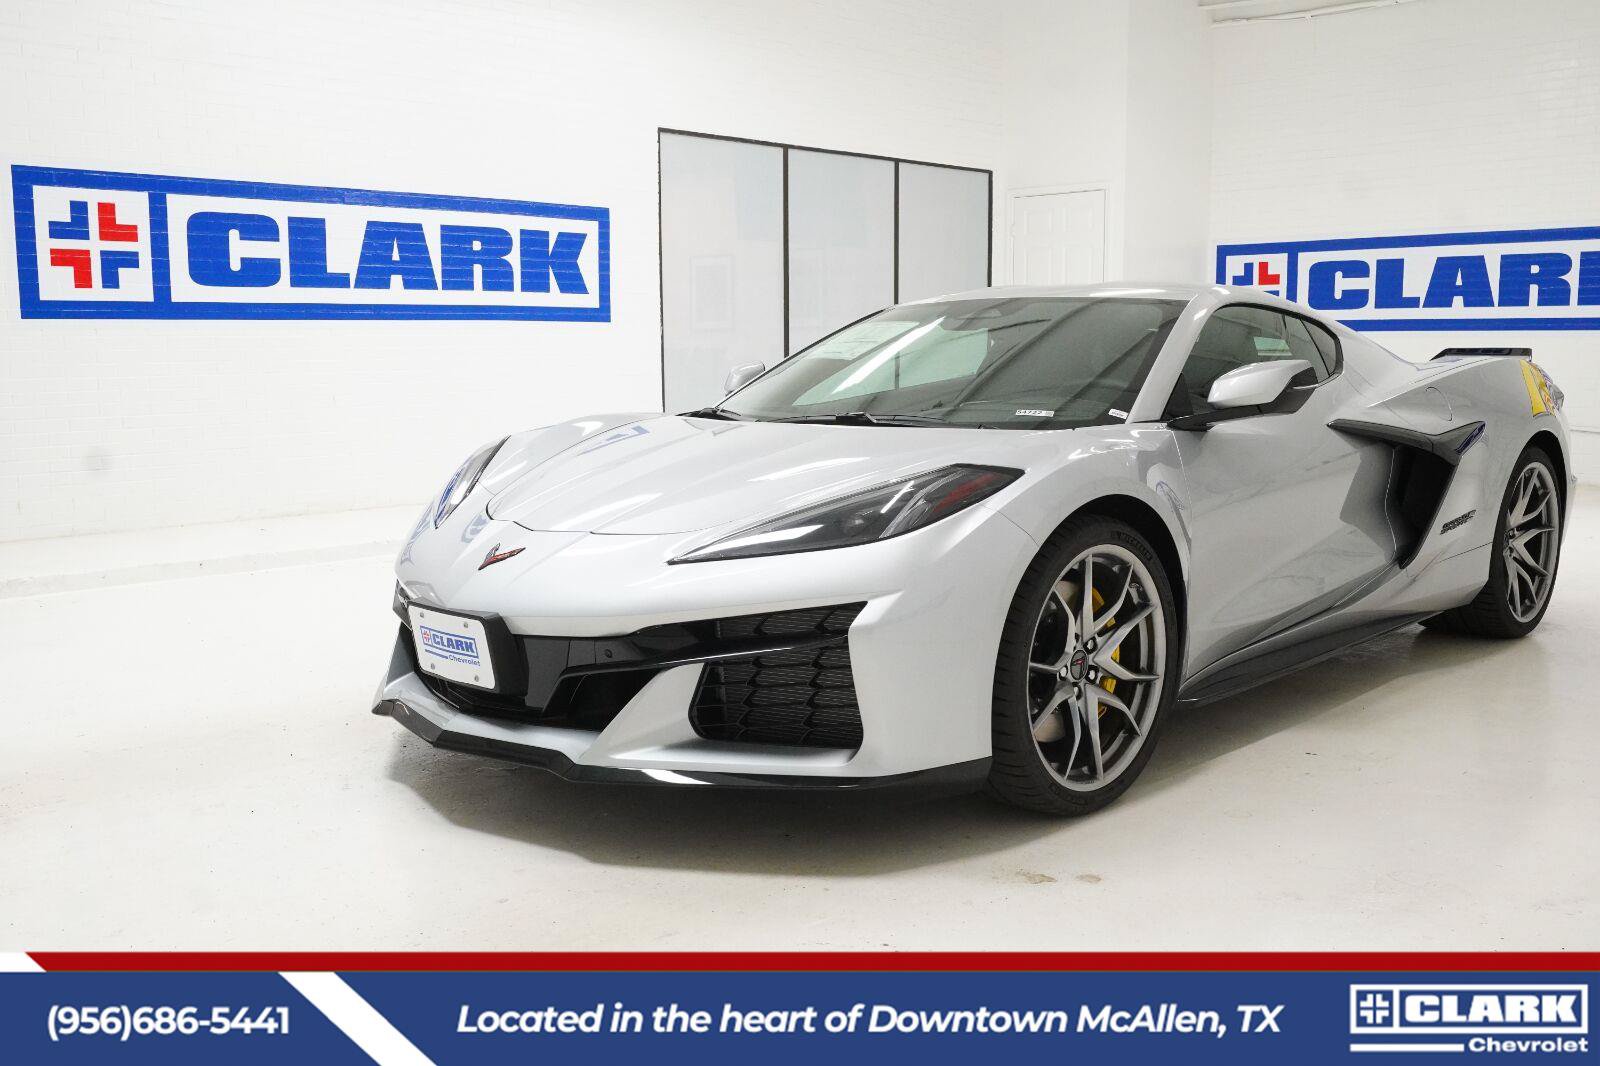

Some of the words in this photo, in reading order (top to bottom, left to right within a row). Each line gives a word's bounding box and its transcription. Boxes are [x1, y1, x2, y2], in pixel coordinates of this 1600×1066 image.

[187, 211, 590, 294] CLARK
[432, 633, 475, 653] CLARK
[448, 654, 481, 667] Chevrolet
